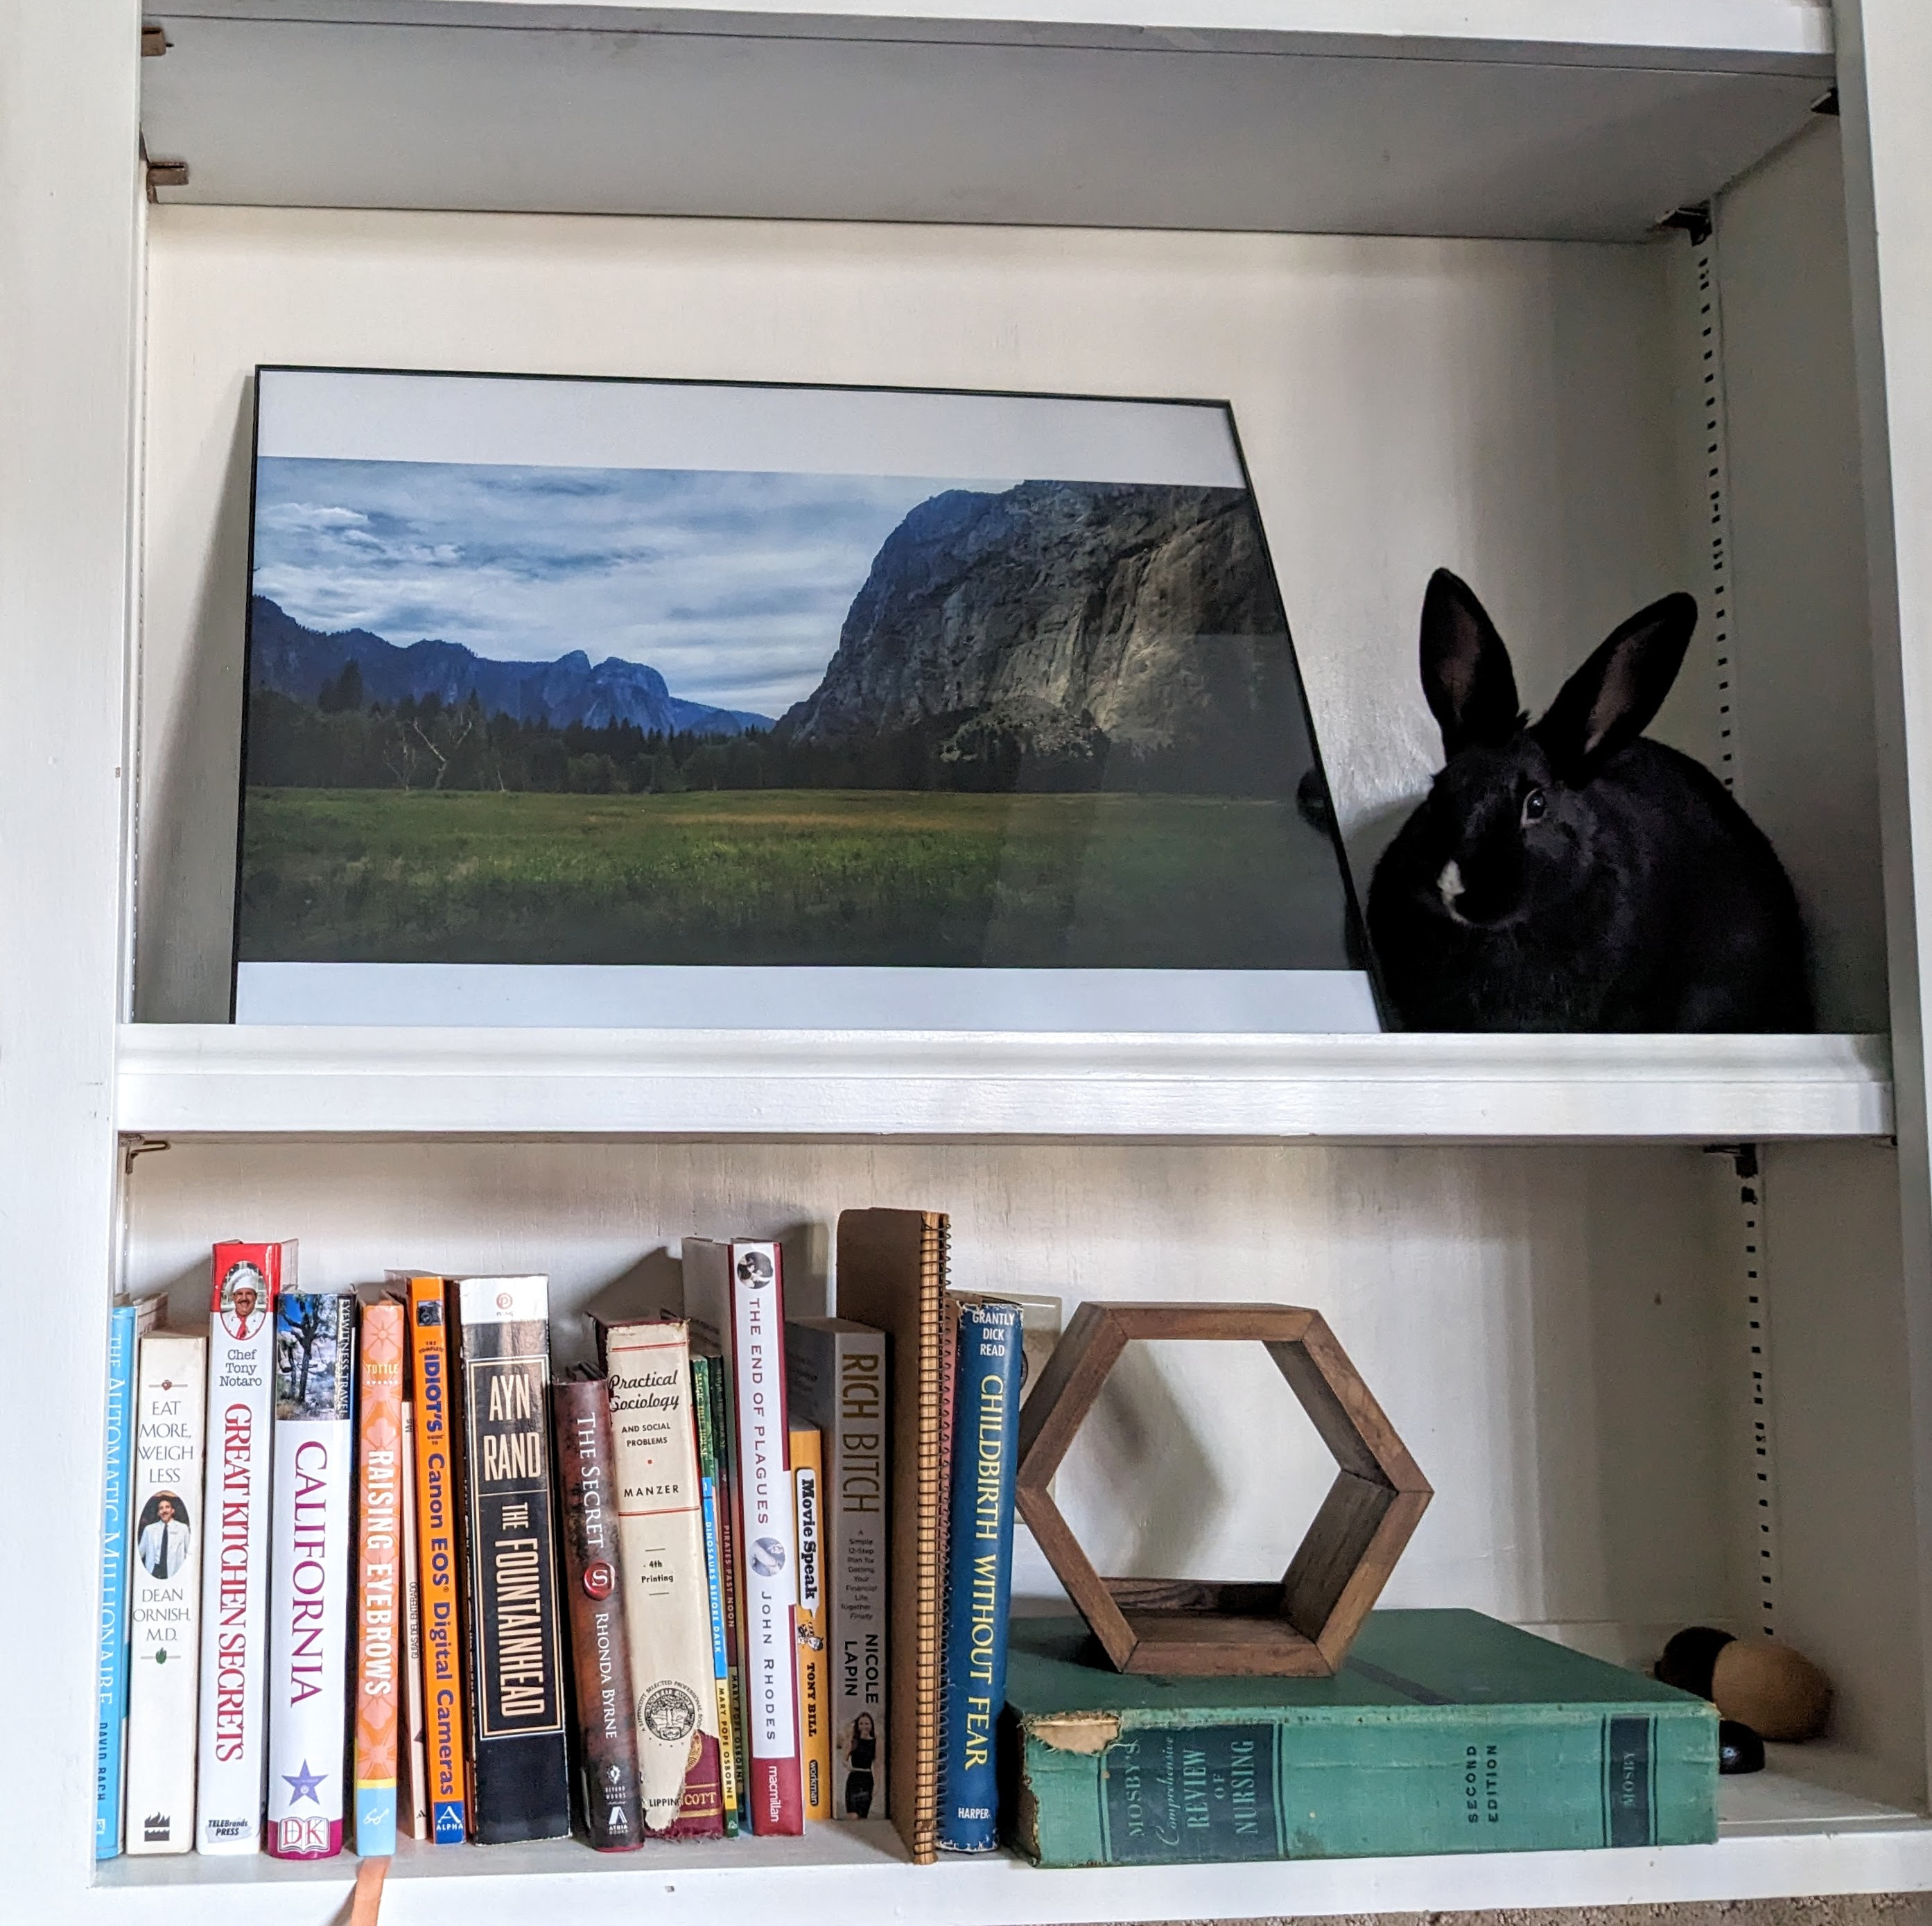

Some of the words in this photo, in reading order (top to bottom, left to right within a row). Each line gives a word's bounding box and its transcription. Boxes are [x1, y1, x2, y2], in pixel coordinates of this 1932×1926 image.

[340, 1299, 351, 1370] EYEWITNESS
[749, 1298, 761, 1335] THE
[972, 1311, 1016, 1326] GRANTLY
[983, 1328, 1004, 1341] DICK
[225, 1363, 256, 1376] Tony
[227, 1348, 256, 1360] Chef
[366, 1364, 399, 1375] TUTTLE
[750, 1345, 763, 1384] END
[980, 1343, 1005, 1356] READ
[219, 1374, 262, 1387] Notaro
[424, 1354, 442, 1432] IDIOT'S
[489, 1374, 531, 1422] AYN
[609, 1369, 678, 1389] Practical
[609, 1392, 679, 1412] Sociology
[695, 1373, 704, 1403] MAGIC
[842, 1353, 879, 1419] RICH
[153, 1401, 181, 1416] EAT
[753, 1392, 765, 1417] OF
[105, 1378, 125, 1521] AUTOMATIC
[139, 1423, 192, 1439] MORE,
[223, 1403, 252, 1495] GREAT
[577, 1412, 596, 1457] THE
[621, 1425, 639, 1434] AND
[642, 1422, 671, 1432] SOCIAL
[627, 1437, 668, 1447] PROBLEMS
[699, 1428, 708, 1457] HOUSE
[138, 1446, 193, 1461] WEIGH
[149, 1468, 180, 1483] LESS
[485, 1432, 541, 1482] RAND
[754, 1426, 768, 1524] PLAGUES
[842, 1434, 880, 1513] BITCH
[975, 1374, 1004, 1541] CHILDBIRTH
[367, 1450, 394, 1550] RAISING
[428, 1453, 445, 1529] Canon
[581, 1466, 604, 1548] SECRET
[624, 1484, 679, 1498] MANZER
[801, 1479, 815, 1537] Movie
[502, 1502, 528, 1530] THE
[219, 1500, 250, 1628] KITCHEN
[649, 1560, 663, 1568] 4th
[706, 1522, 716, 1580] DINOSAURS
[724, 1525, 732, 1564] PIRATES
[290, 1441, 328, 1708] CALIFORNIA
[641, 1573, 674, 1584] Printing
[801, 1541, 818, 1599] Speak
[142, 1589, 183, 1603] DEAN
[409, 1581, 418, 1620] ENTERADO
[710, 1585, 720, 1621] BEFORE
[761, 1592, 773, 1645] JOHN
[969, 1554, 997, 1684] WITHOUT
[146, 1629, 177, 1642] M.D.
[365, 1563, 392, 1696] EYEBROWS
[410, 1620, 419, 1635] DEL
[429, 1602, 451, 1680] Digital
[494, 1538, 545, 1717] FOUNTAINHEAD
[595, 1613, 612, 1684] RHONDA
[807, 1663, 817, 1700] TONY
[844, 1640, 858, 1697] LAPIN
[865, 1634, 879, 1704] NICOLE
[216, 1633, 246, 1762] SECRETS
[602, 1689, 617, 1739] BYRNE
[646, 1681, 672, 1693] SELECTED
[674, 1681, 702, 1712] PROFESSIONAL
[764, 1658, 776, 1740] RHODES
[436, 1689, 456, 1795] Cameras
[808, 1703, 817, 1737] BILL
[964, 1696, 991, 1771] FEAR
[718, 1688, 726, 1715] MARY
[724, 1751, 733, 1800] OSBORNE
[768, 1766, 780, 1823] macmillan
[1156, 1736, 1181, 1846] Comprehensive
[1183, 1749, 1210, 1828] REVIEW
[1213, 1773, 1226, 1799] OF
[1231, 1741, 1259, 1834] NURSING
[1465, 1746, 1479, 1823] SECOND
[1486, 1744, 1499, 1823] EDITION
[1622, 1751, 1636, 1807] MOSBY
[208, 1818, 248, 1828] TELEBrands
[216, 1828, 239, 1836] PRESS
[284, 1819, 324, 1846] DK
[958, 1807, 989, 1819] HARPER
